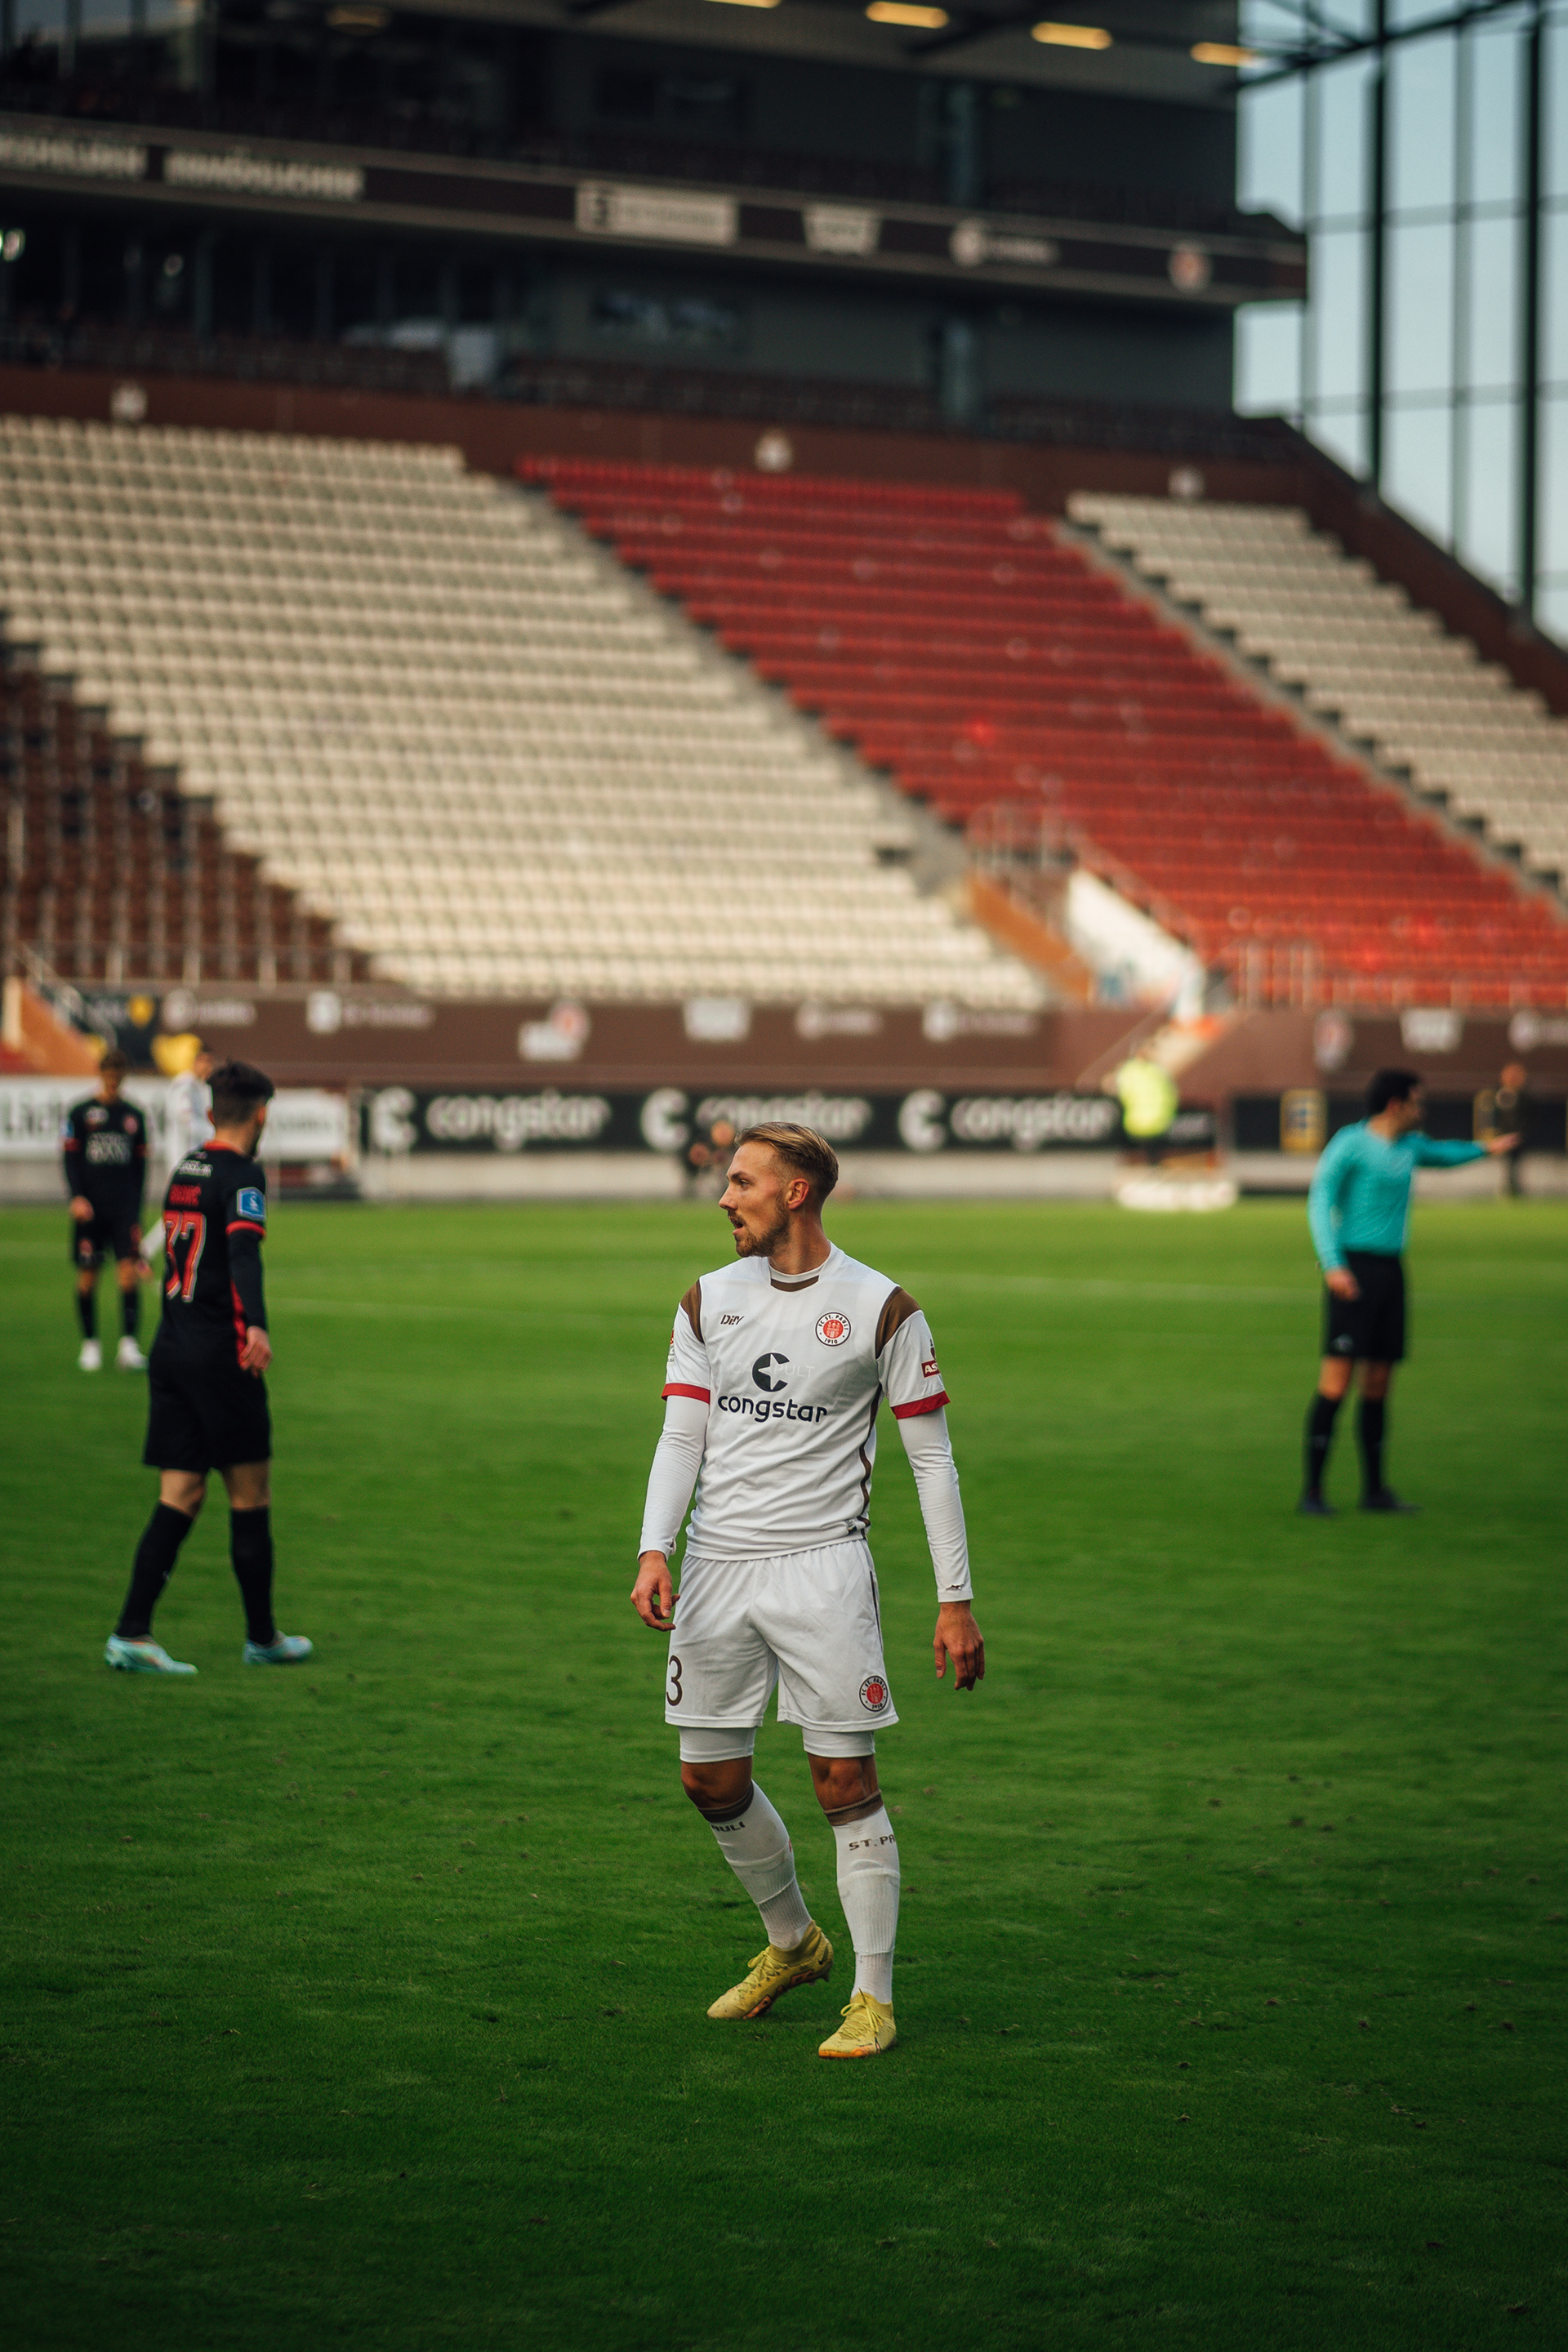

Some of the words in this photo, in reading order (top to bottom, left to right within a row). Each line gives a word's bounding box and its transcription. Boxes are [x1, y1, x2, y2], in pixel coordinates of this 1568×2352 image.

[425, 1087, 612, 1152] congstar
[950, 1091, 1120, 1152] congstar
[835, 1315, 849, 1330] PAULI
[718, 1394, 827, 1423] congstar
[666, 1655, 683, 1706] 3
[849, 1838, 878, 1851] ST.
